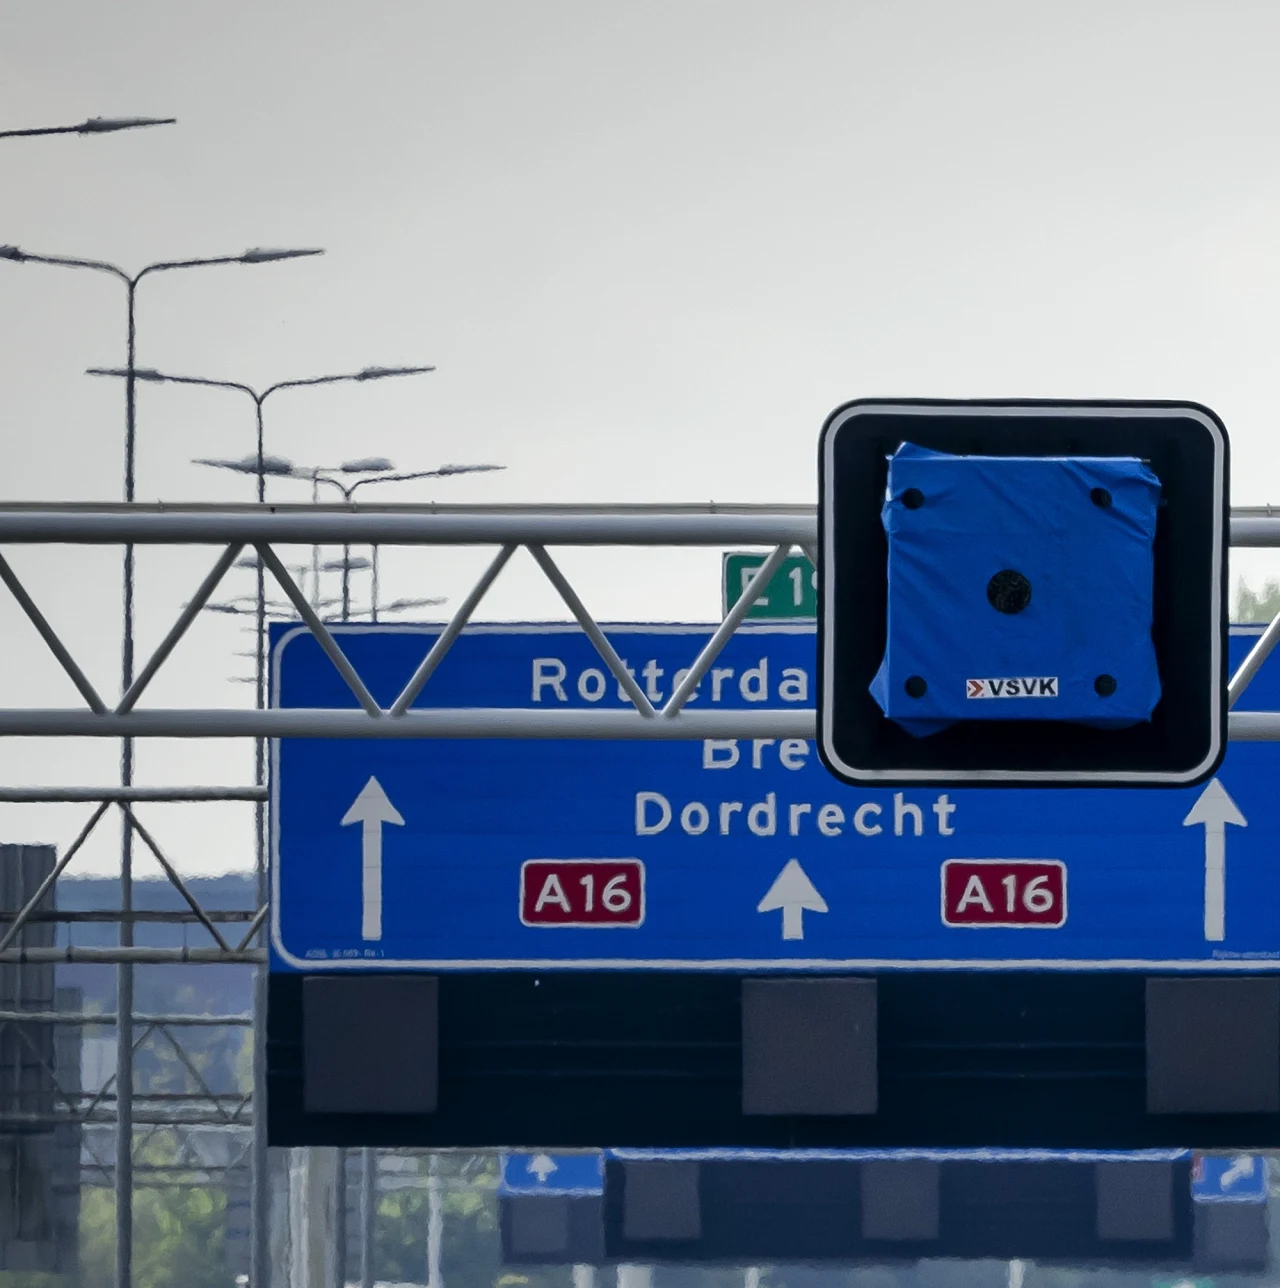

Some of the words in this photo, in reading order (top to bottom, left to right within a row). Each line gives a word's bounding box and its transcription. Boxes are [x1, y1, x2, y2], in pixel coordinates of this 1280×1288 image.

[789, 567, 818, 606] 1
[988, 678, 1056, 696] VSVK
[635, 792, 956, 836] Dordrecht
[534, 873, 632, 914] A16
[955, 873, 1055, 914] A16
